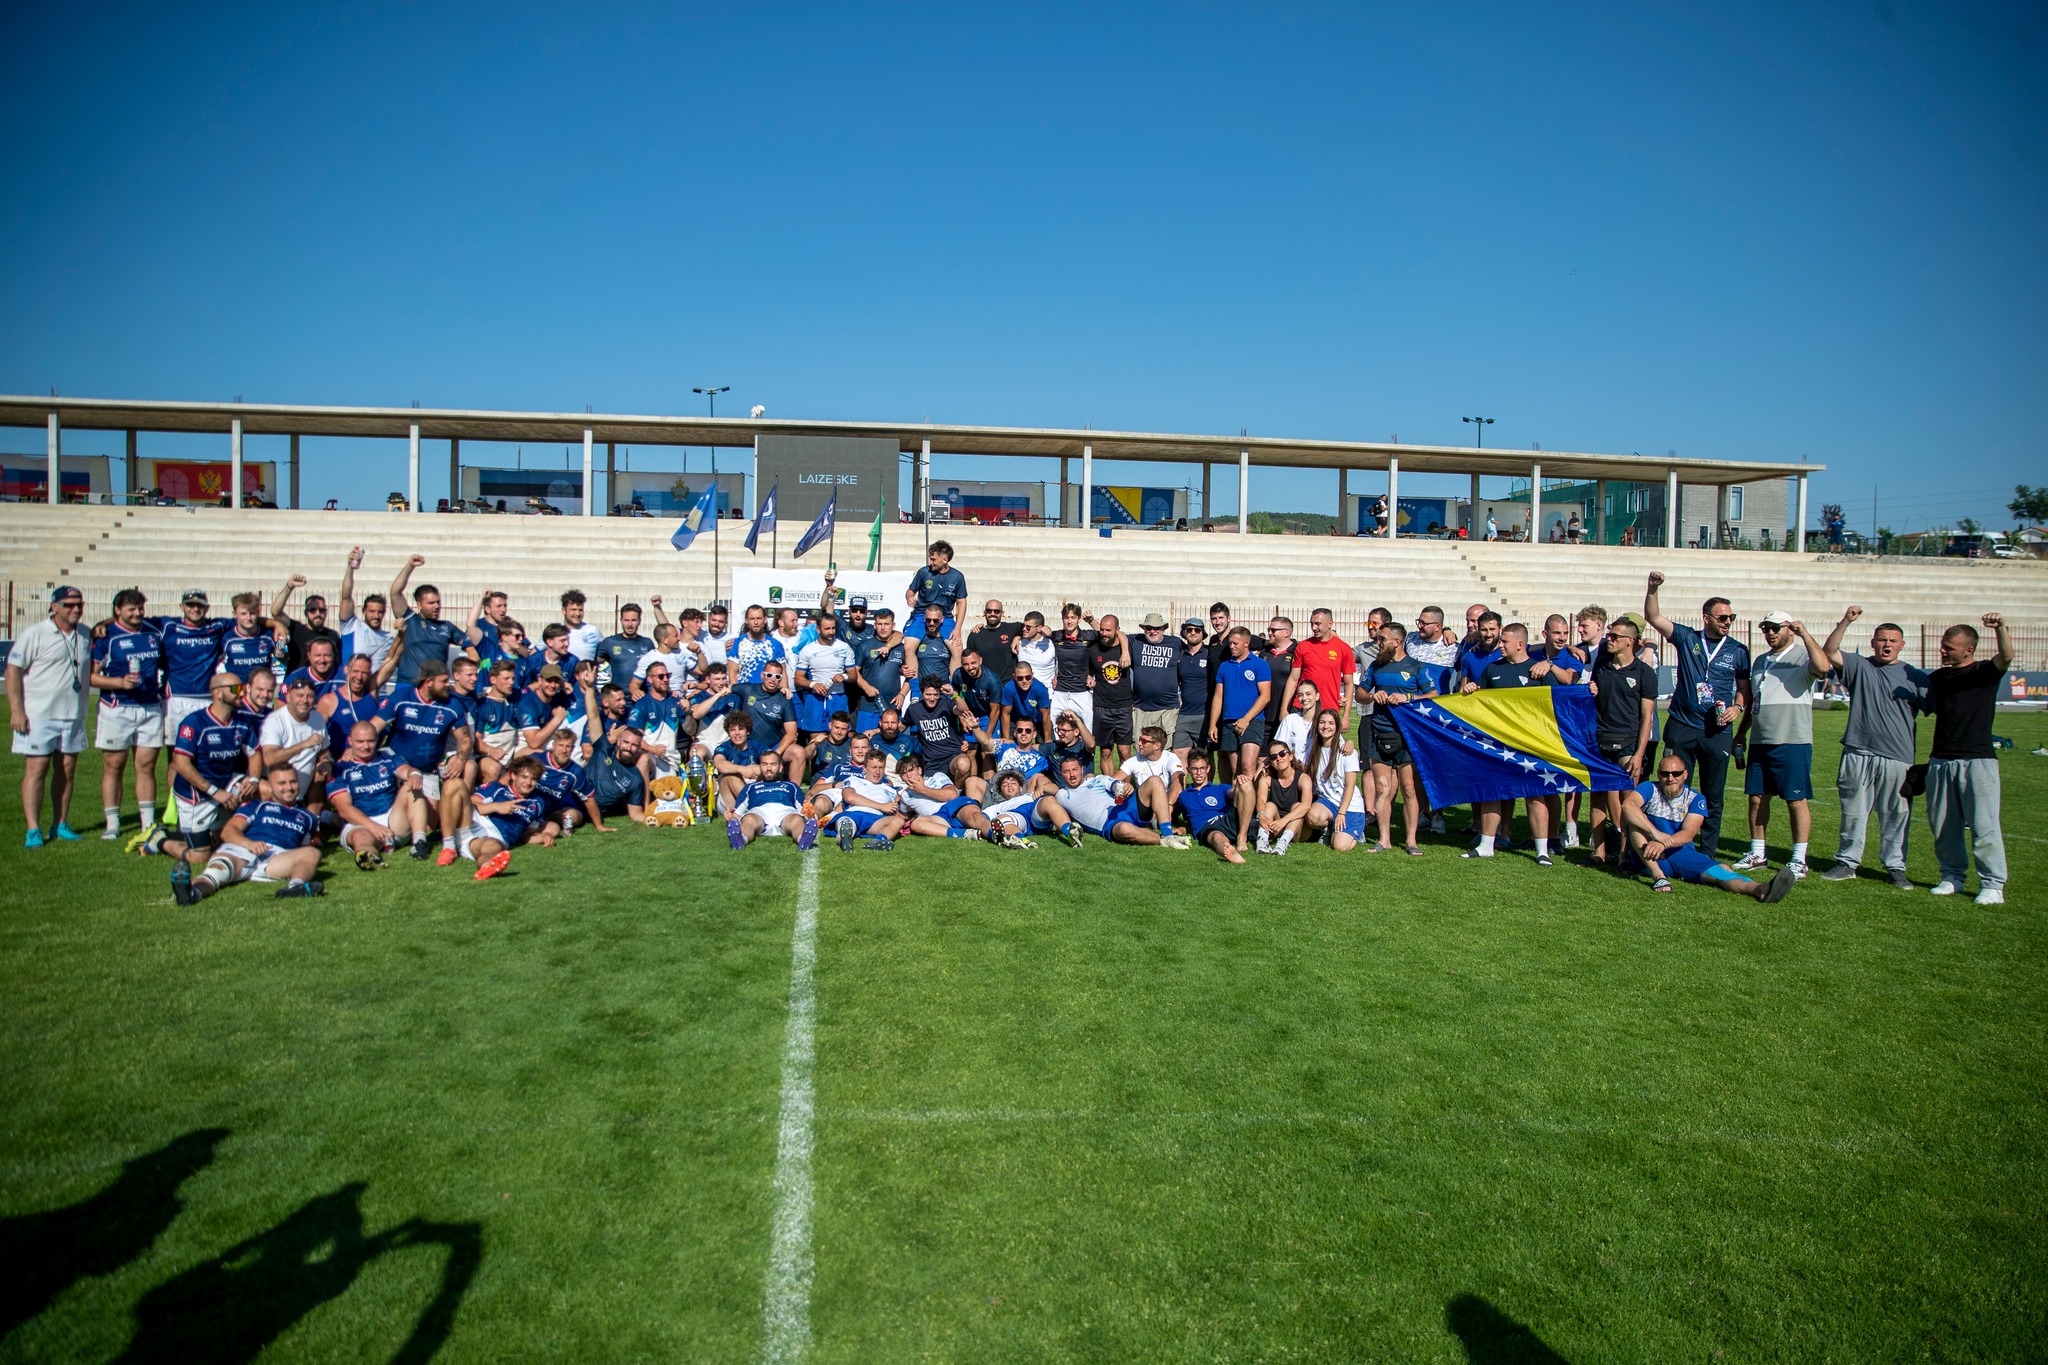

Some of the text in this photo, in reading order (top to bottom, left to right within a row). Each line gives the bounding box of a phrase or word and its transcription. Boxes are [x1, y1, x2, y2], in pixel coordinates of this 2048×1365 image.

[799, 473, 858, 485] LAIZESKE
[784, 592, 816, 600] CONFERENCE
[1141, 643, 1173, 658] KOSOVO
[1141, 655, 1171, 668] RUGBY
[919, 716, 949, 731] KOSOVO
[924, 727, 951, 742] RUGBY
